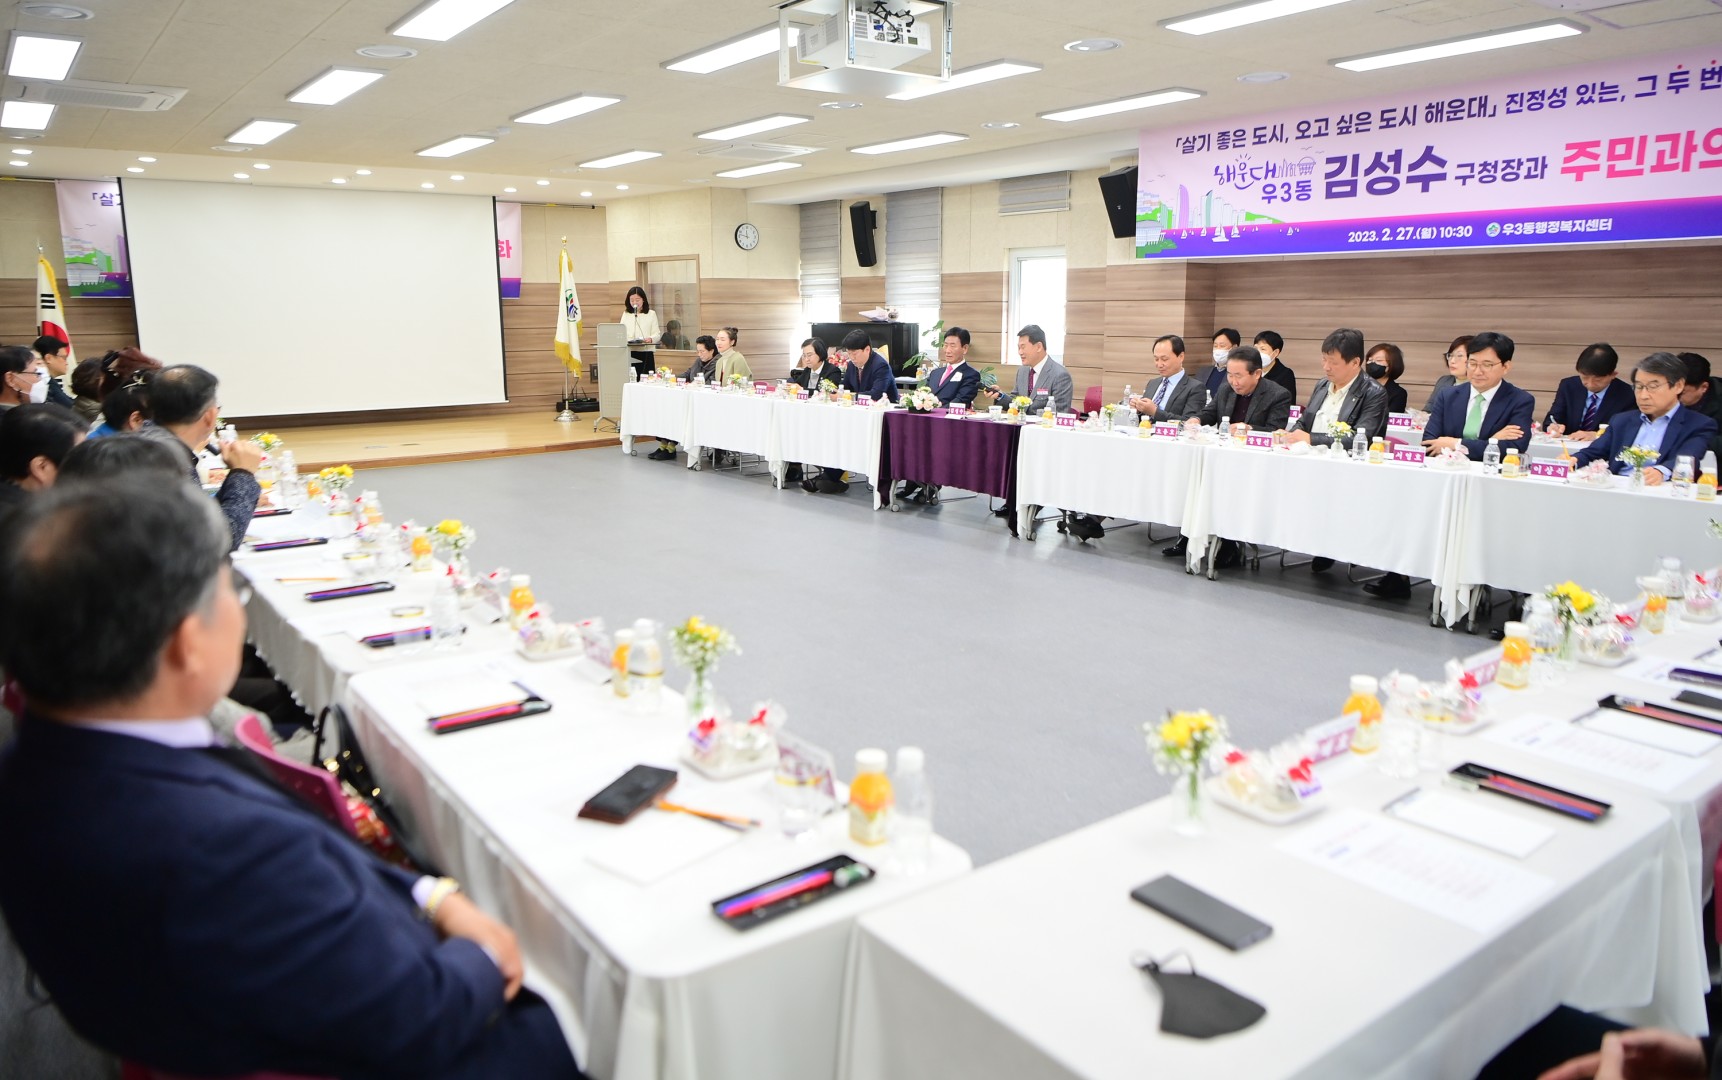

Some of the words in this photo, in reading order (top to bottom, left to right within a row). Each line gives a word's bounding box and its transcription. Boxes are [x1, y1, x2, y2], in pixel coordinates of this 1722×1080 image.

[1175, 134, 1211, 155] 「살기
[1216, 128, 1247, 151] 좋은
[1252, 123, 1289, 146] 도시,
[1295, 117, 1329, 141] 오고
[1336, 111, 1372, 136] 싶은
[1378, 104, 1418, 130] 도시
[1424, 95, 1497, 124] 해운대」
[1505, 86, 1568, 115] 진정성
[1576, 81, 1626, 107] 있는,
[1635, 75, 1658, 98] 그
[1667, 70, 1690, 94] 두
[1213, 159, 1278, 189] 해운대
[1261, 179, 1313, 204] 우3동
[1324, 145, 1448, 200] 김성수
[1454, 155, 1548, 186] 구청장과
[1347, 231, 1379, 243] 2023.
[1381, 228, 1394, 241] 2.
[1439, 225, 1473, 239] 10:30
[1502, 218, 1613, 236] 우3동행정복지센터
[1533, 464, 1565, 477] 이상식
